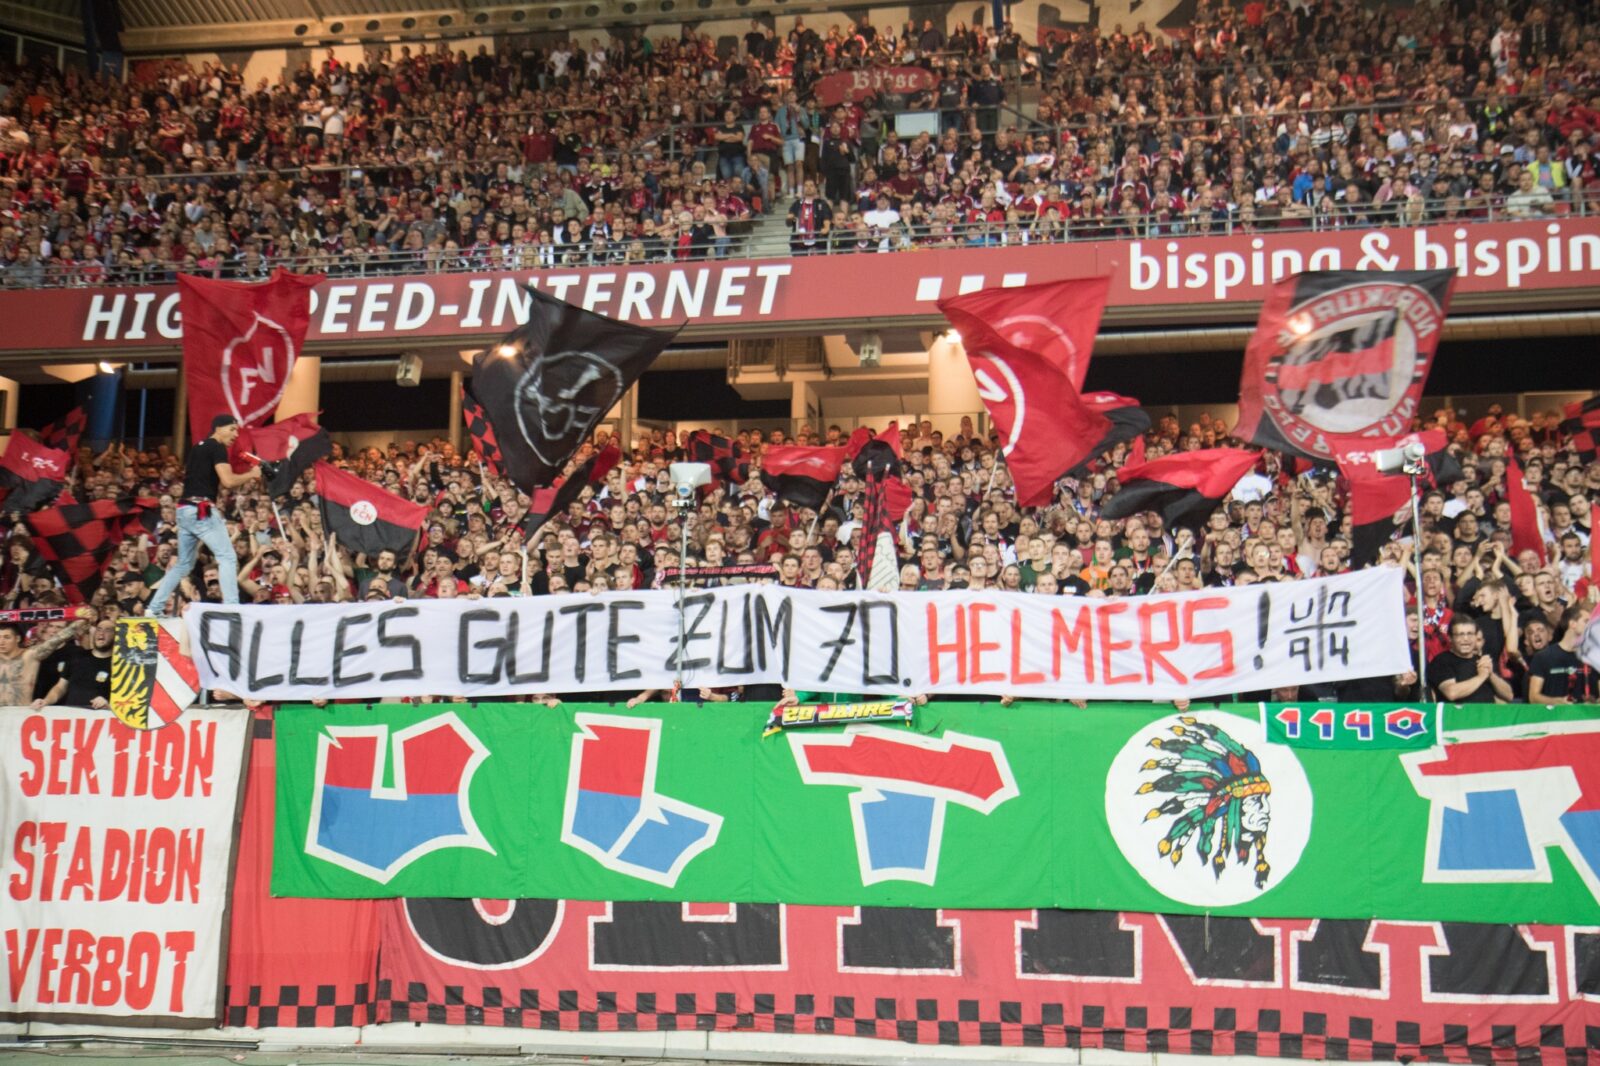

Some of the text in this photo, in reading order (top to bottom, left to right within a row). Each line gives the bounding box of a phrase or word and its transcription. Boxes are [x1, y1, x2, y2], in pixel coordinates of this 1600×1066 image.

[1356, 231, 1399, 272] &
[200, 607, 423, 691] ALLES
[459, 600, 645, 685] GUTE
[665, 592, 792, 682] ZUM
[783, 701, 895, 725] 20 JAHRE
[1276, 707, 1427, 740] 1140
[20, 714, 217, 801] SEKTION
[9, 820, 205, 905] STADION
[4, 928, 196, 1013] VERBOT
